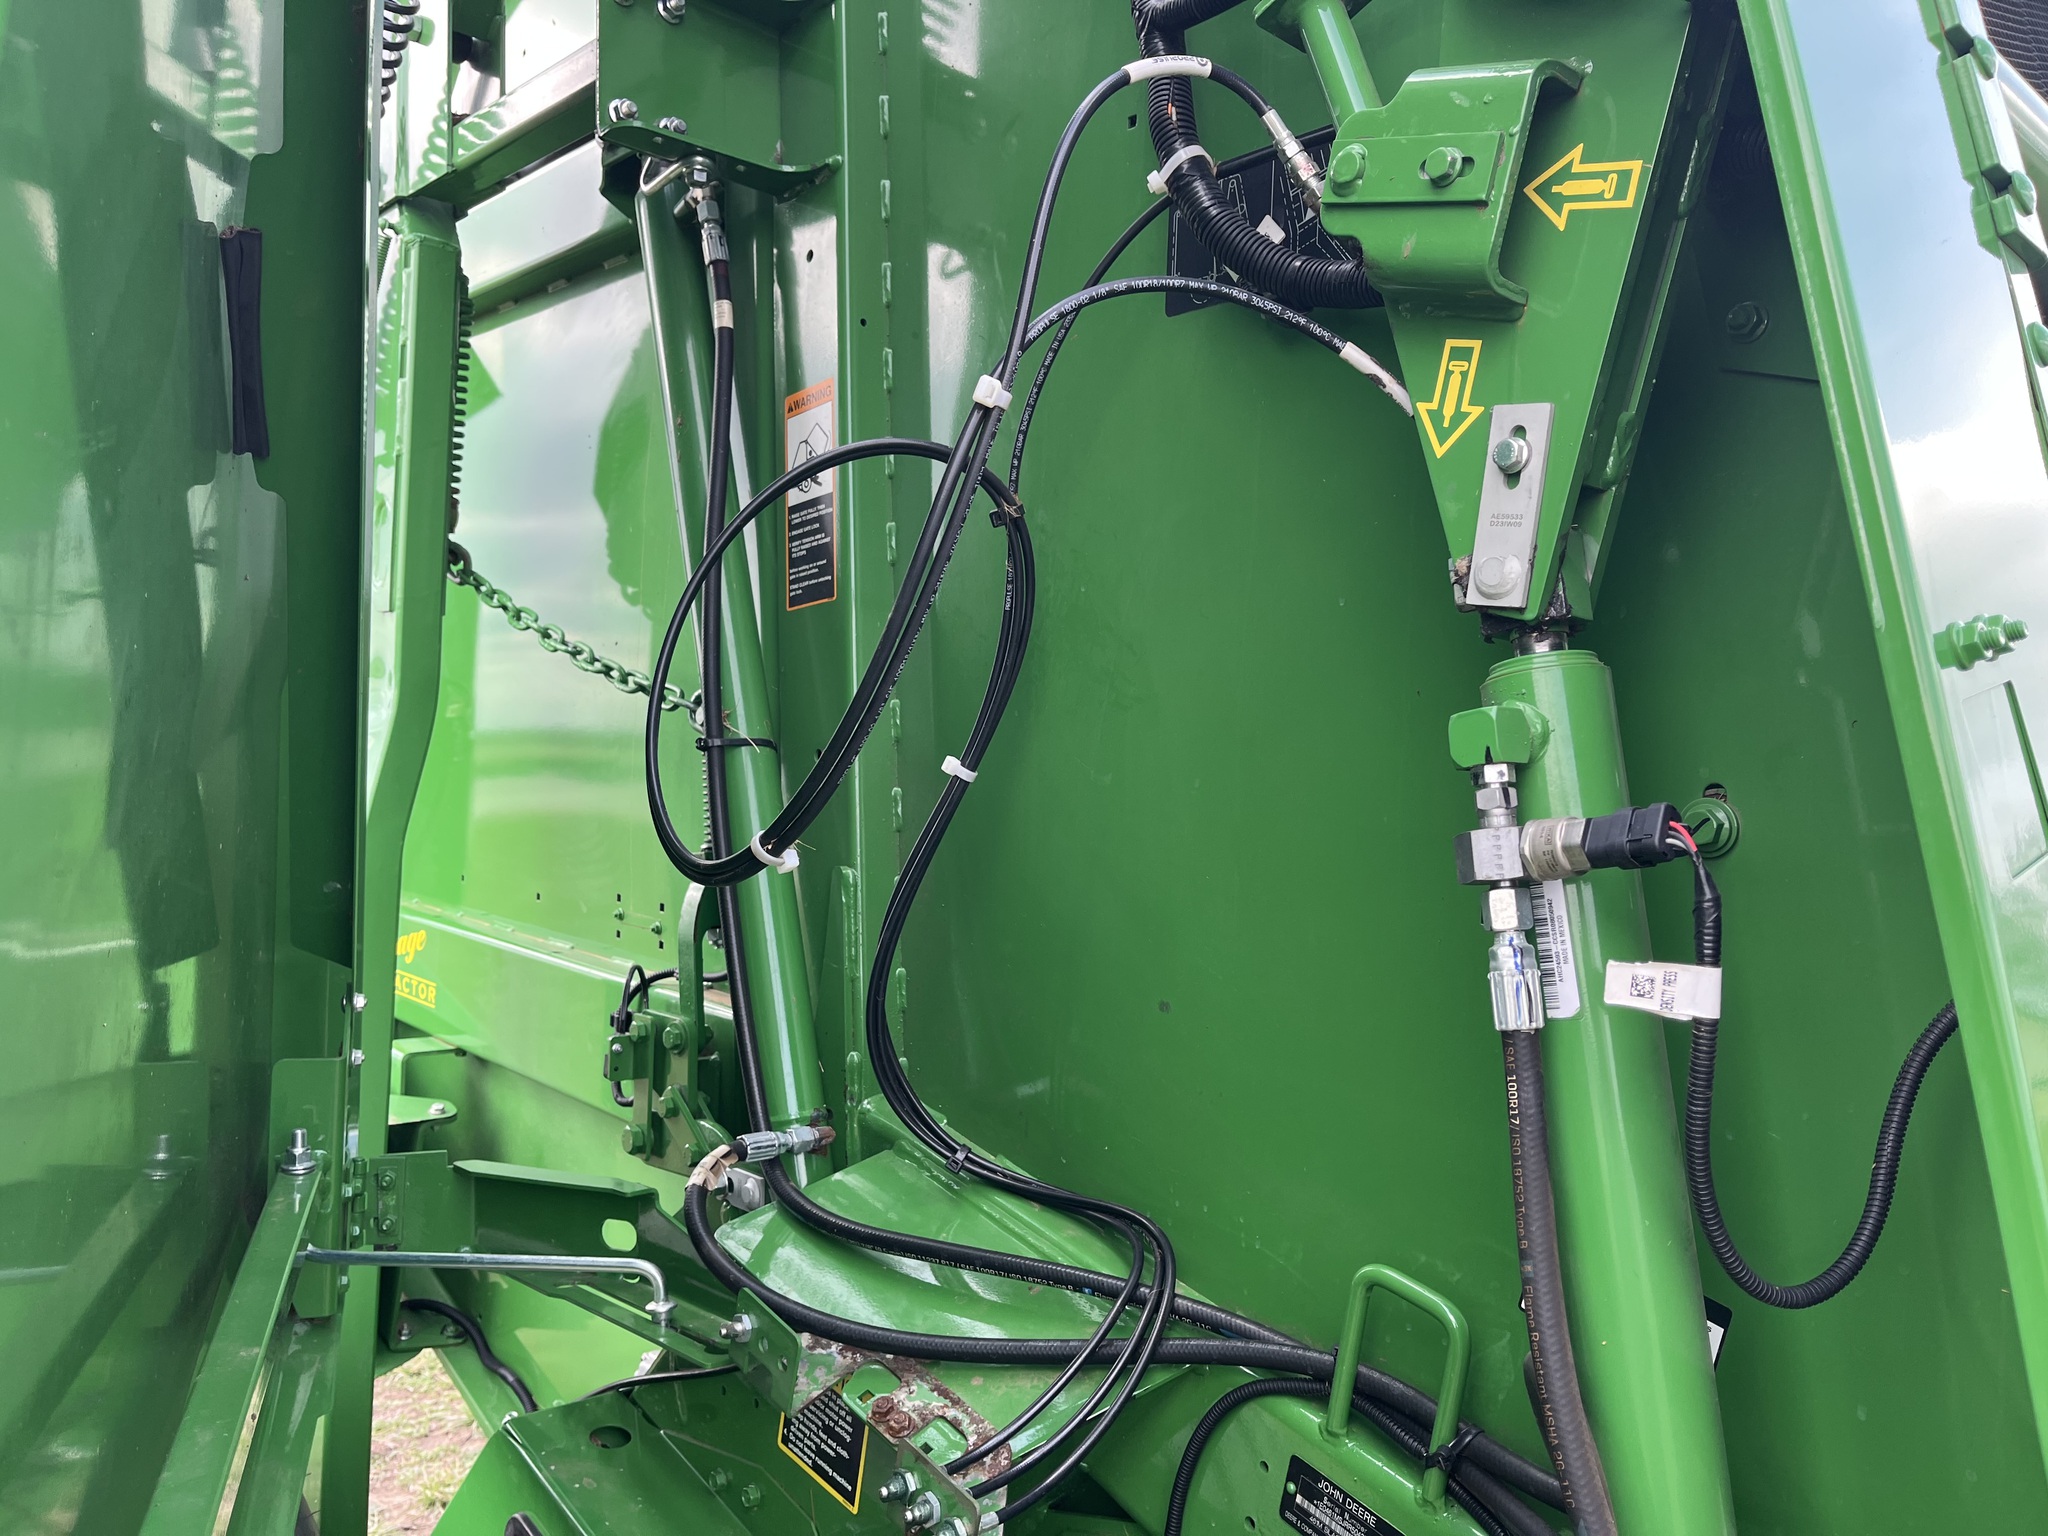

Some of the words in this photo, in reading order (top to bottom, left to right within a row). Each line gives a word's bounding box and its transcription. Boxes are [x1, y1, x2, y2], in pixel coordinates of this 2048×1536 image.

[1062, 295, 1090, 314] 1800-02
[1250, 295, 1282, 316] 3045PSI
[1044, 350, 1054, 366] MADE
[1057, 329, 1066, 340] USA
[793, 385, 832, 411] WARNING
[1556, 914, 1566, 938] MEXICO
[1560, 939, 1566, 947] IN
[1561, 947, 1570, 964] MADE
[1663, 970, 1678, 987] PRESS
[1504, 1046, 1516, 1070] SAE
[1511, 1134, 1521, 1156] ISO
[1513, 1161, 1524, 1202] 18752
[1524, 1285, 1535, 1328] Flame
[1531, 1333, 1548, 1399] Resistant
[1542, 1404, 1559, 1447] MSHA
[1318, 1480, 1344, 1503] JOHN
[1346, 1498, 1377, 1528] DEERE
[1323, 1496, 1342, 1514] Serial
[1344, 1512, 1368, 1532] Number
[1284, 1510, 1297, 1524] DEERE
